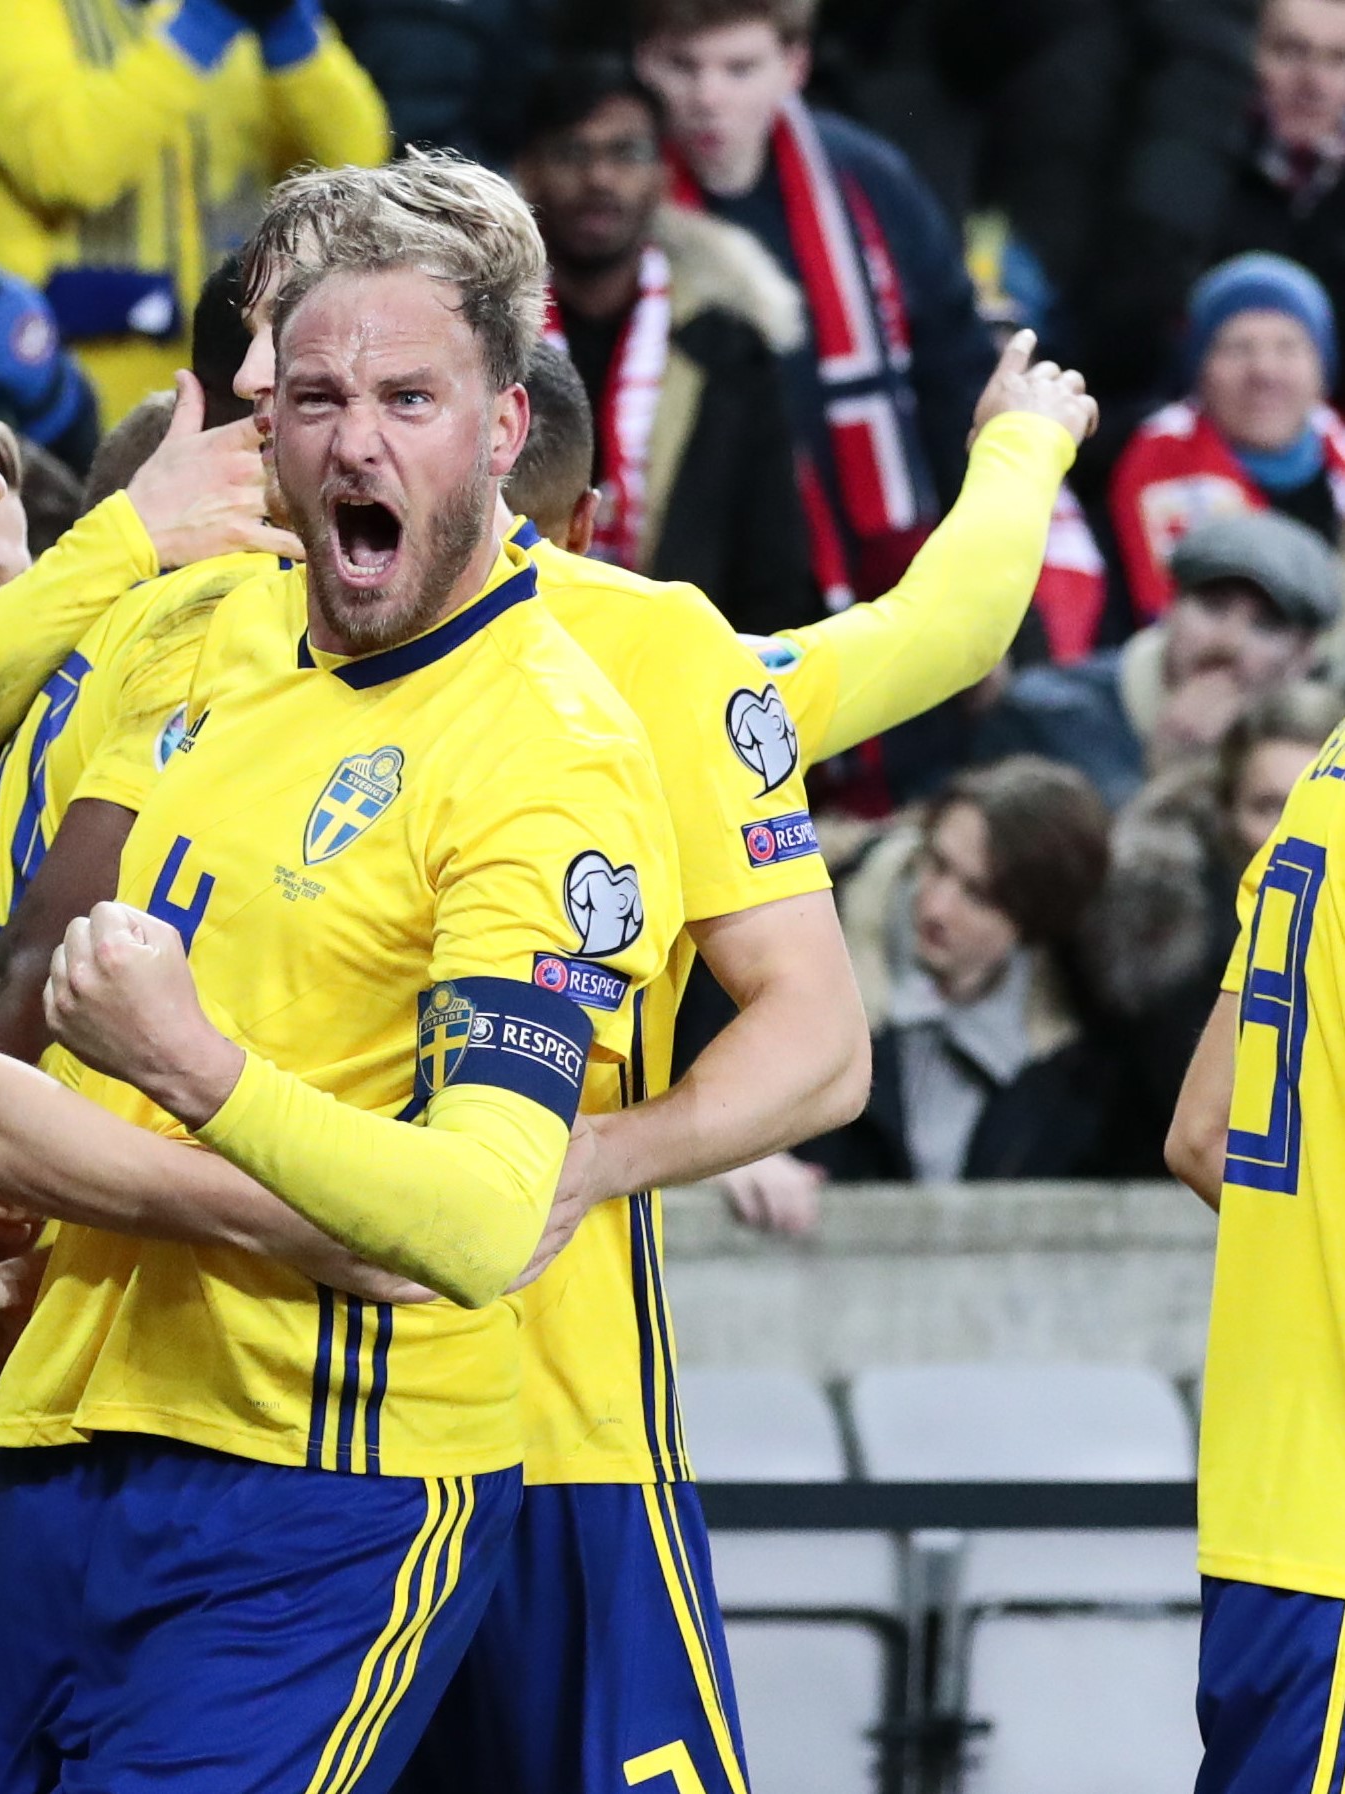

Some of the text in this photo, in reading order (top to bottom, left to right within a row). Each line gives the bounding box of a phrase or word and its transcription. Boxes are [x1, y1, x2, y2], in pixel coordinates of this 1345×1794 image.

[346, 773, 388, 801] SVERIGE
[569, 970, 628, 1000] RESPECT
[423, 1010, 463, 1030] SVERIGE
[502, 1022, 583, 1078] RESPECT
